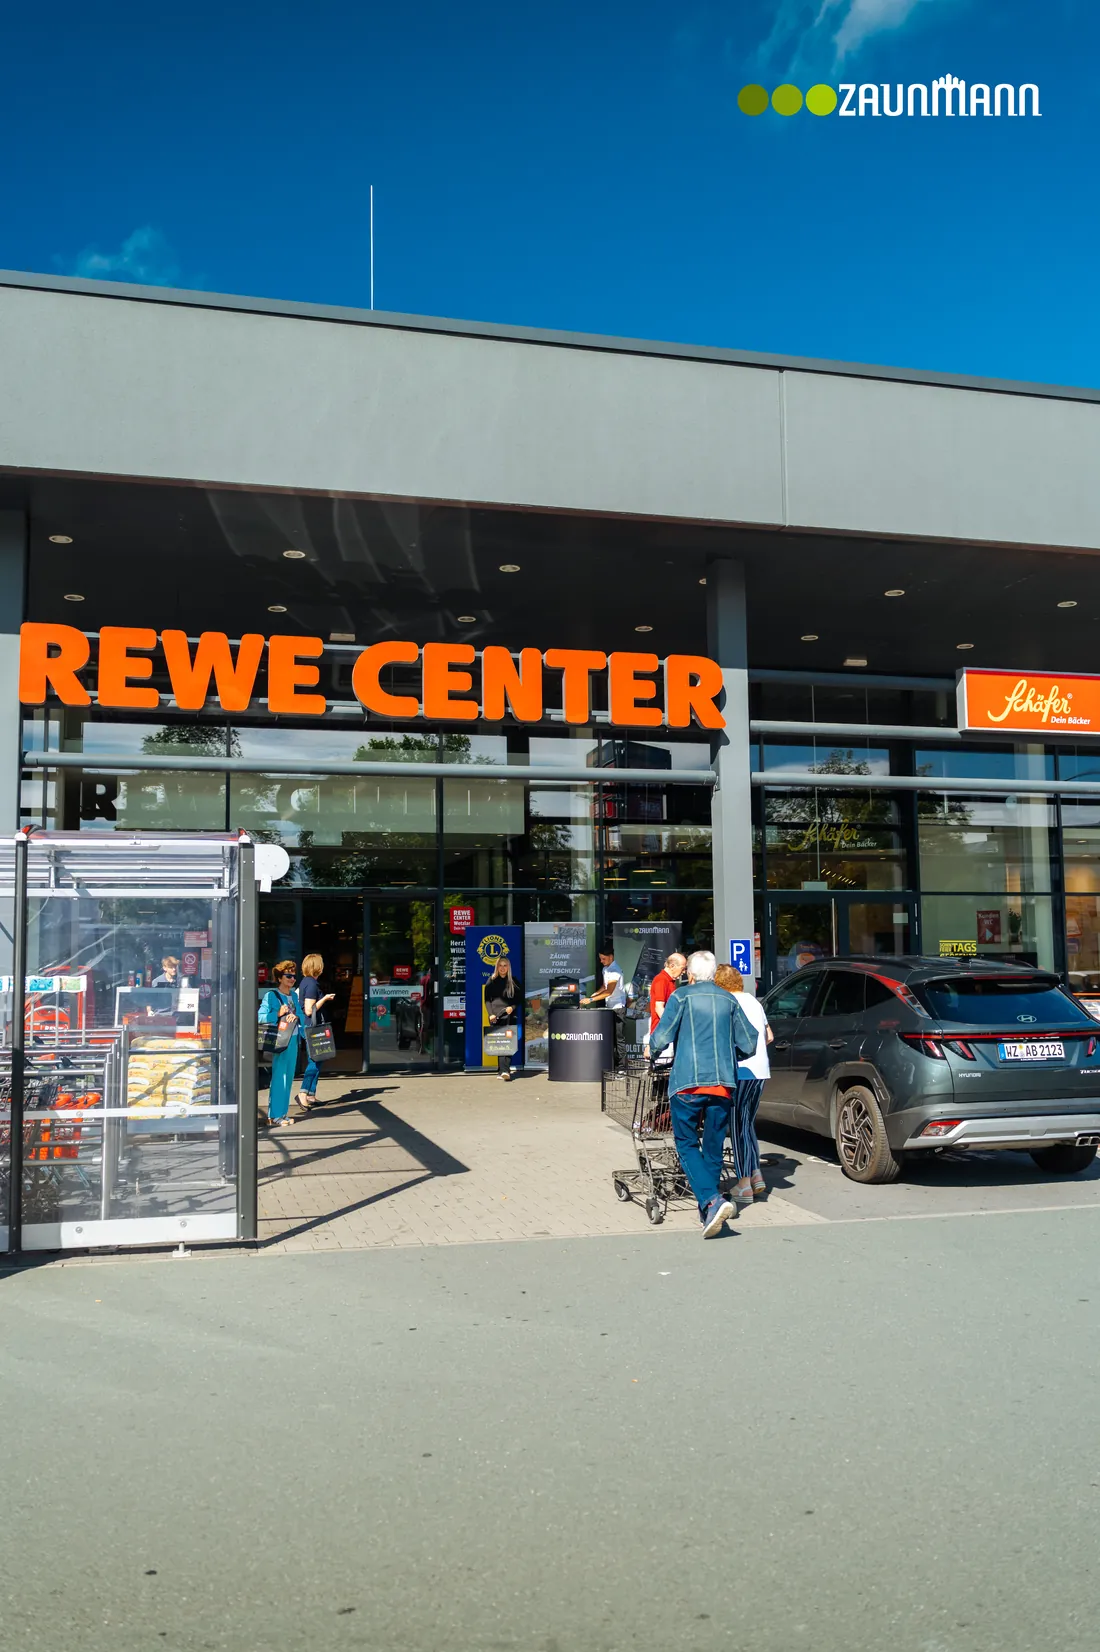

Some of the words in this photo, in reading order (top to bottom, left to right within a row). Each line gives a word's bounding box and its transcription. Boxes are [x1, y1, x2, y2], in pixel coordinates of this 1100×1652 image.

[18, 622, 326, 716] REWE
[351, 640, 727, 730] CENTER
[987, 679, 1071, 723] Schäfer
[1050, 716, 1066, 724] Dein
[1067, 717, 1091, 725] Bäcker
[841, 840, 856, 849] Dein
[483, 935, 503, 943] LIONS
[489, 944, 498, 955] L
[733, 943, 745, 961] P
[371, 988, 409, 996] Willkommen
[565, 1031, 604, 1041] ZAUNMANN
[1005, 1045, 1019, 1058] WZ
[1025, 1045, 1038, 1057] AB
[1039, 1044, 1063, 1057] 2123
